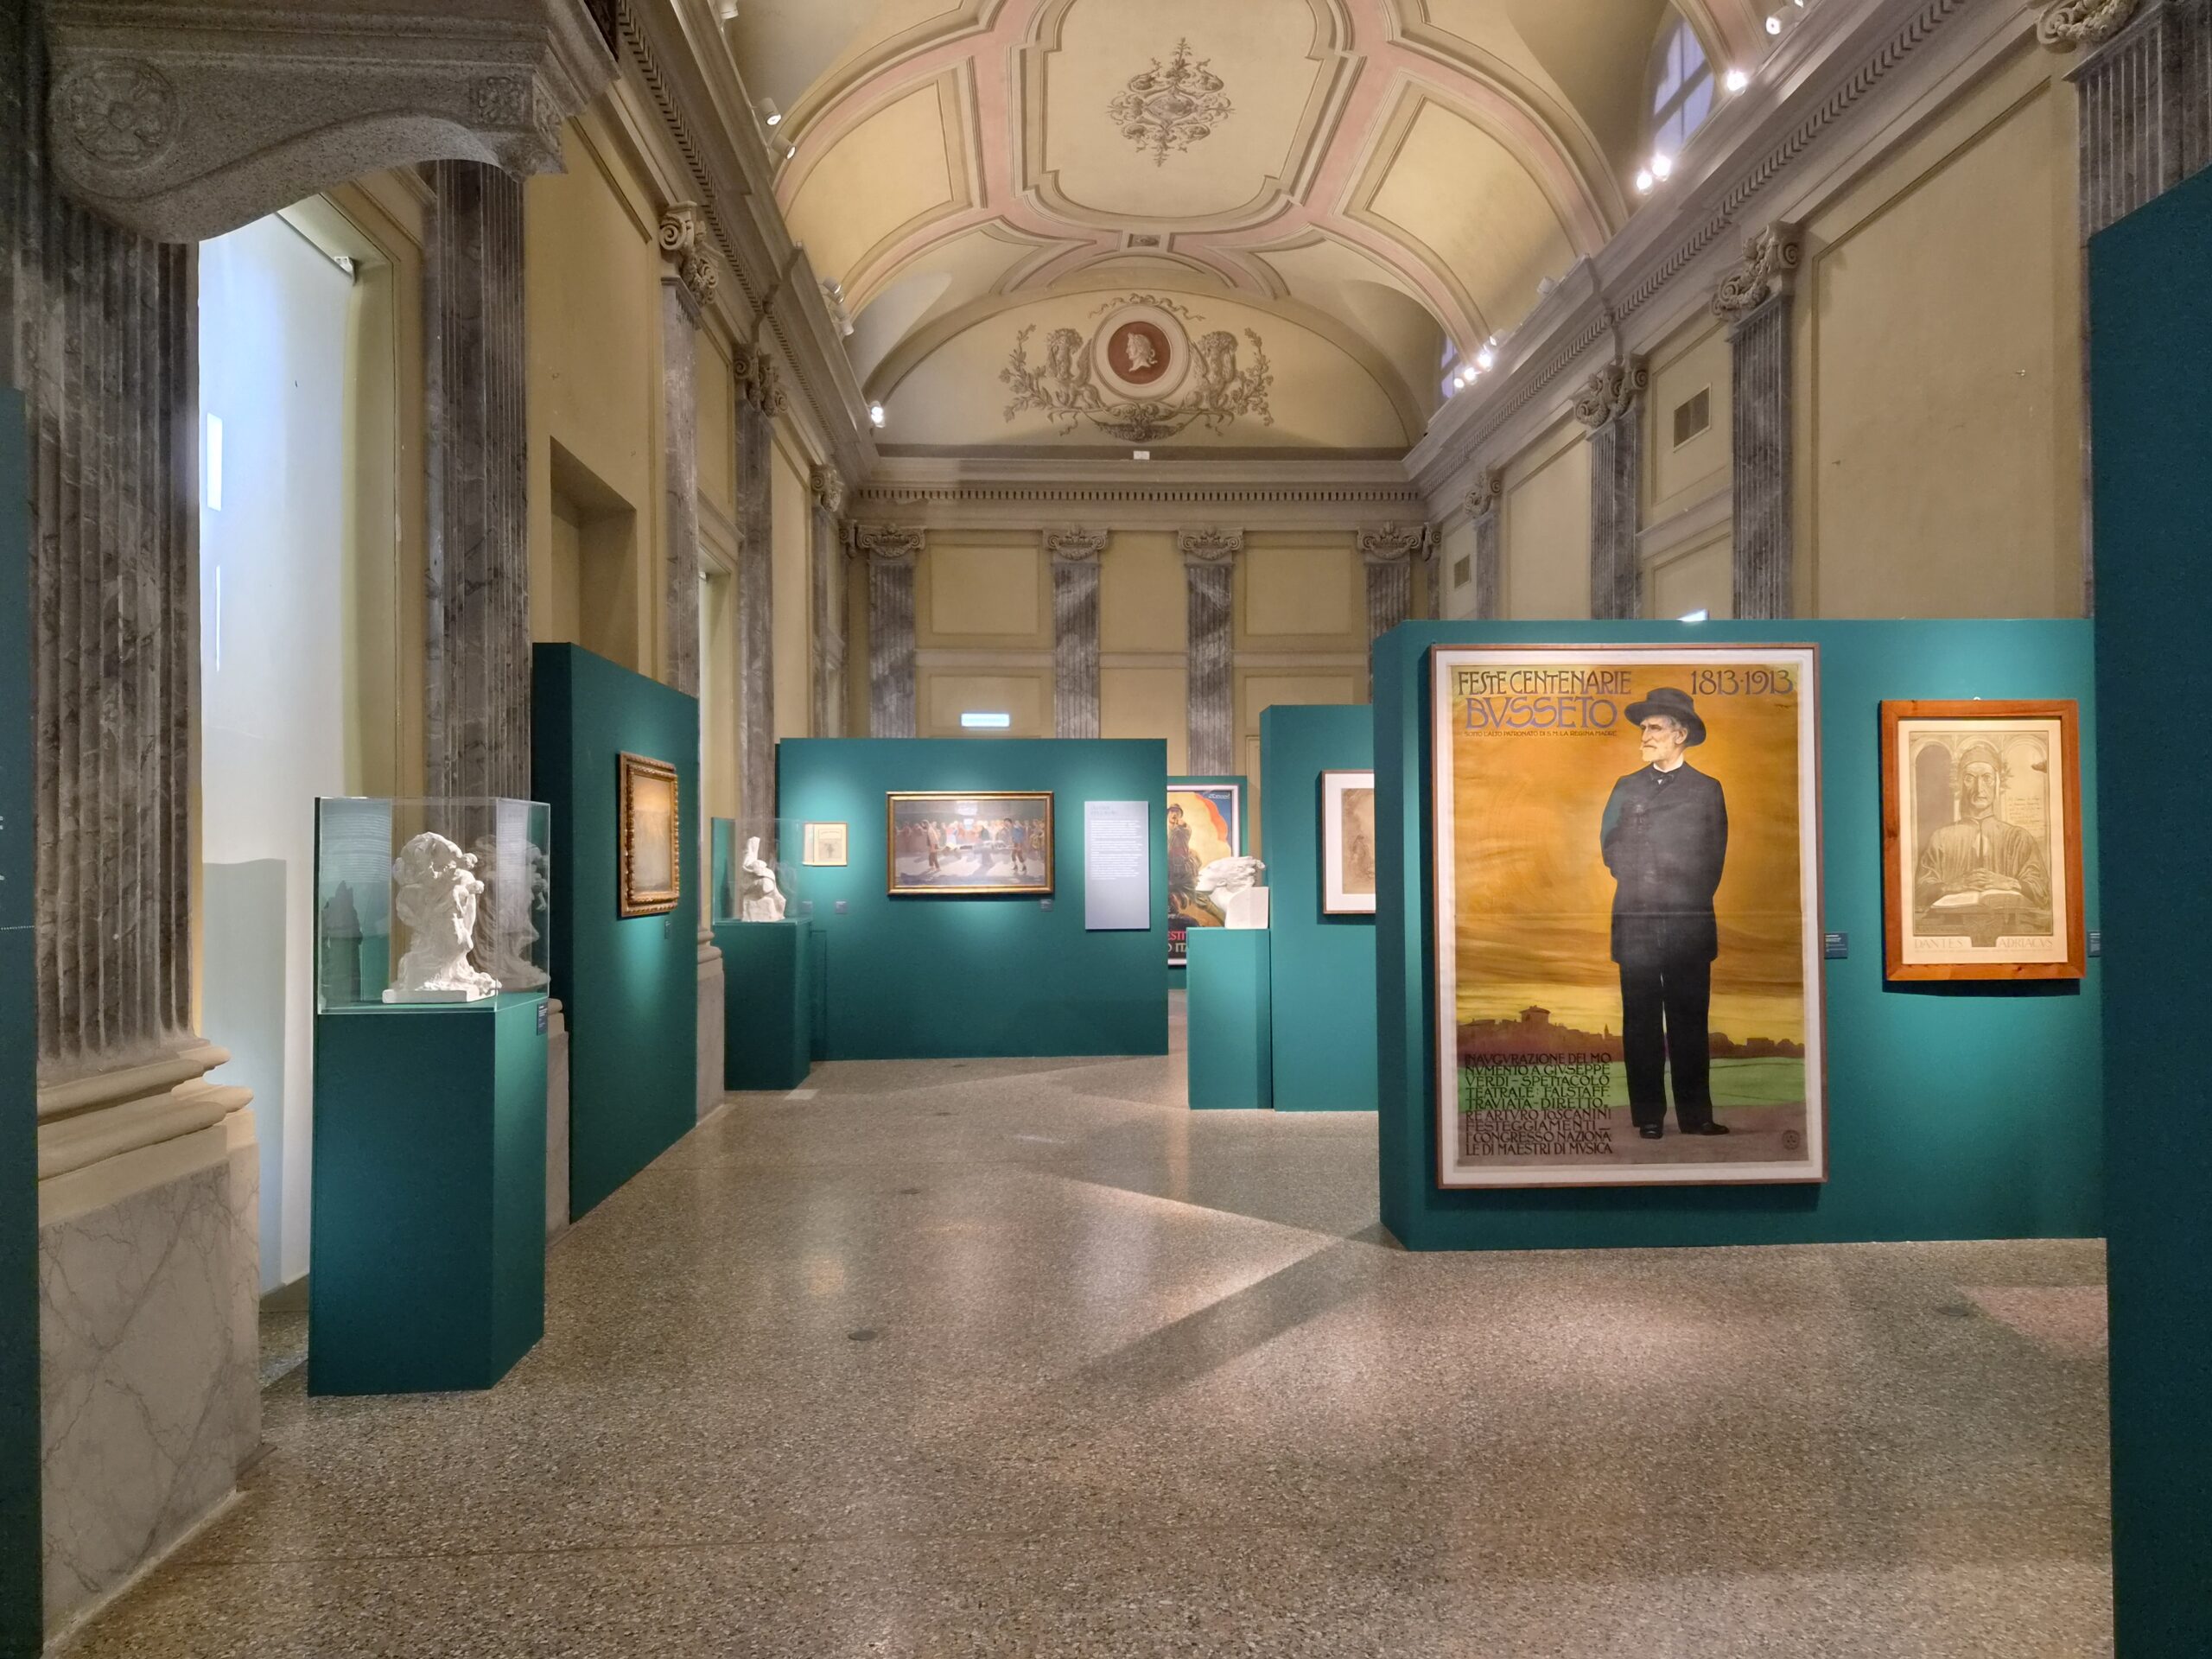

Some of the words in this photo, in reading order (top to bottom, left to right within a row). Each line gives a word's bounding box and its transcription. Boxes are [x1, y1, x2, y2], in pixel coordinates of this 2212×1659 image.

[1458, 671, 1507, 696] FESTE
[1510, 671, 1632, 695] CENTENARIE
[1568, 1052, 1586, 1065] DEL
[1531, 1065, 1541, 1076] A
[1465, 1076, 1509, 1087] VERDI
[1521, 1075, 1610, 1087] SPETTACOLO
[1465, 1098, 1532, 1109] TRAVIATA
[1465, 1109, 1483, 1122] RE
[1541, 1109, 1611, 1120] TOSCANINI
[1465, 1120, 1596, 1132] FESTEGGIAMENTI
[1473, 1132, 1554, 1143] CONGRESSO
[1557, 1131, 1611, 1142] NAZIONA
[1465, 1143, 1479, 1156] LE
[1482, 1143, 1494, 1156] DI
[1497, 1142, 1550, 1156] MAESTRI
[1554, 1142, 1566, 1155] DI
